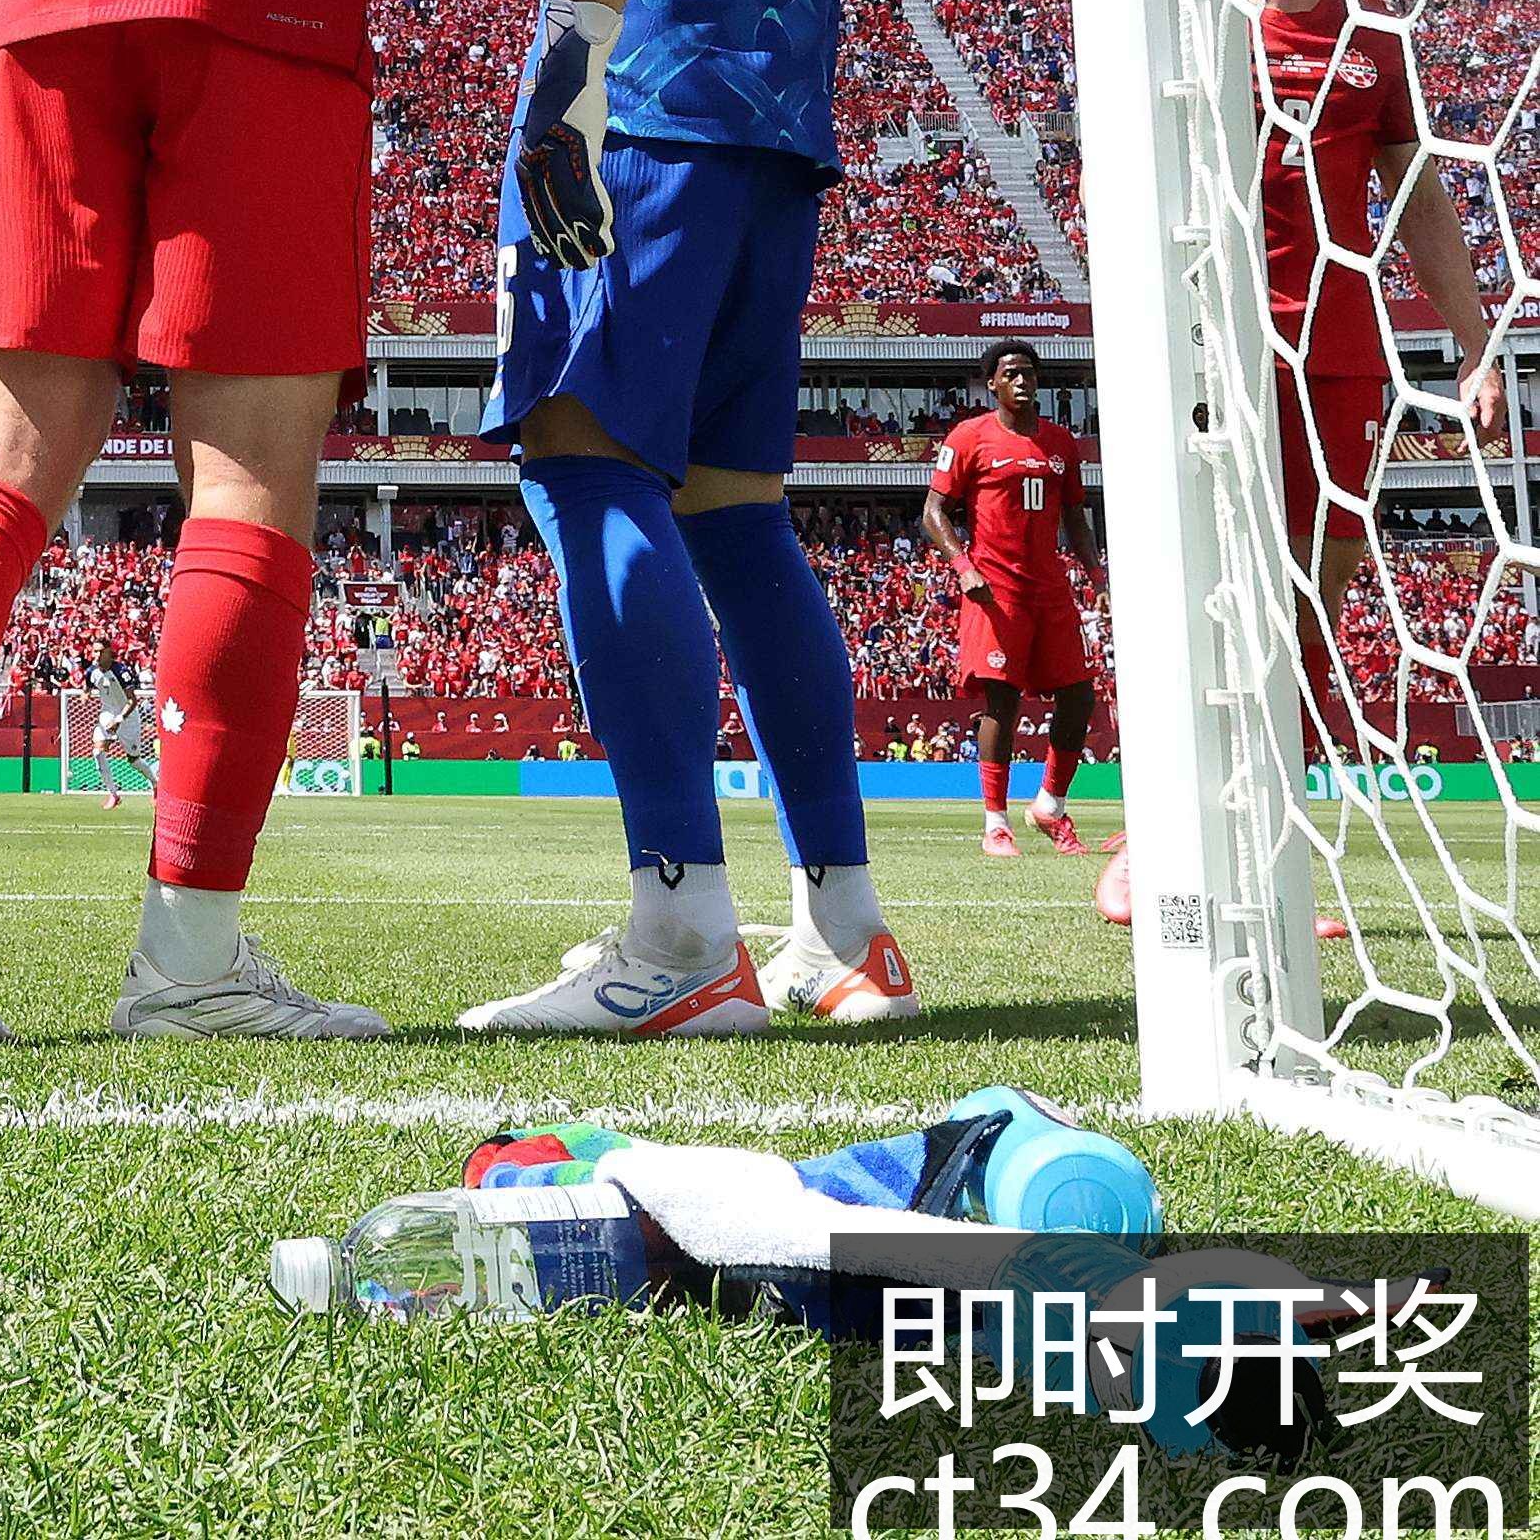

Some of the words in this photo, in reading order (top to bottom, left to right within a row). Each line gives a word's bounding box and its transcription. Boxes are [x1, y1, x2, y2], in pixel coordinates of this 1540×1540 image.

[1489, 301, 1540, 319] WOR
[980, 312, 1070, 329] #FIFAWorldCup
[101, 439, 137, 454] NDE
[140, 439, 165, 454] DE
[1022, 477, 1044, 510] 10
[1306, 764, 1443, 801] amco
